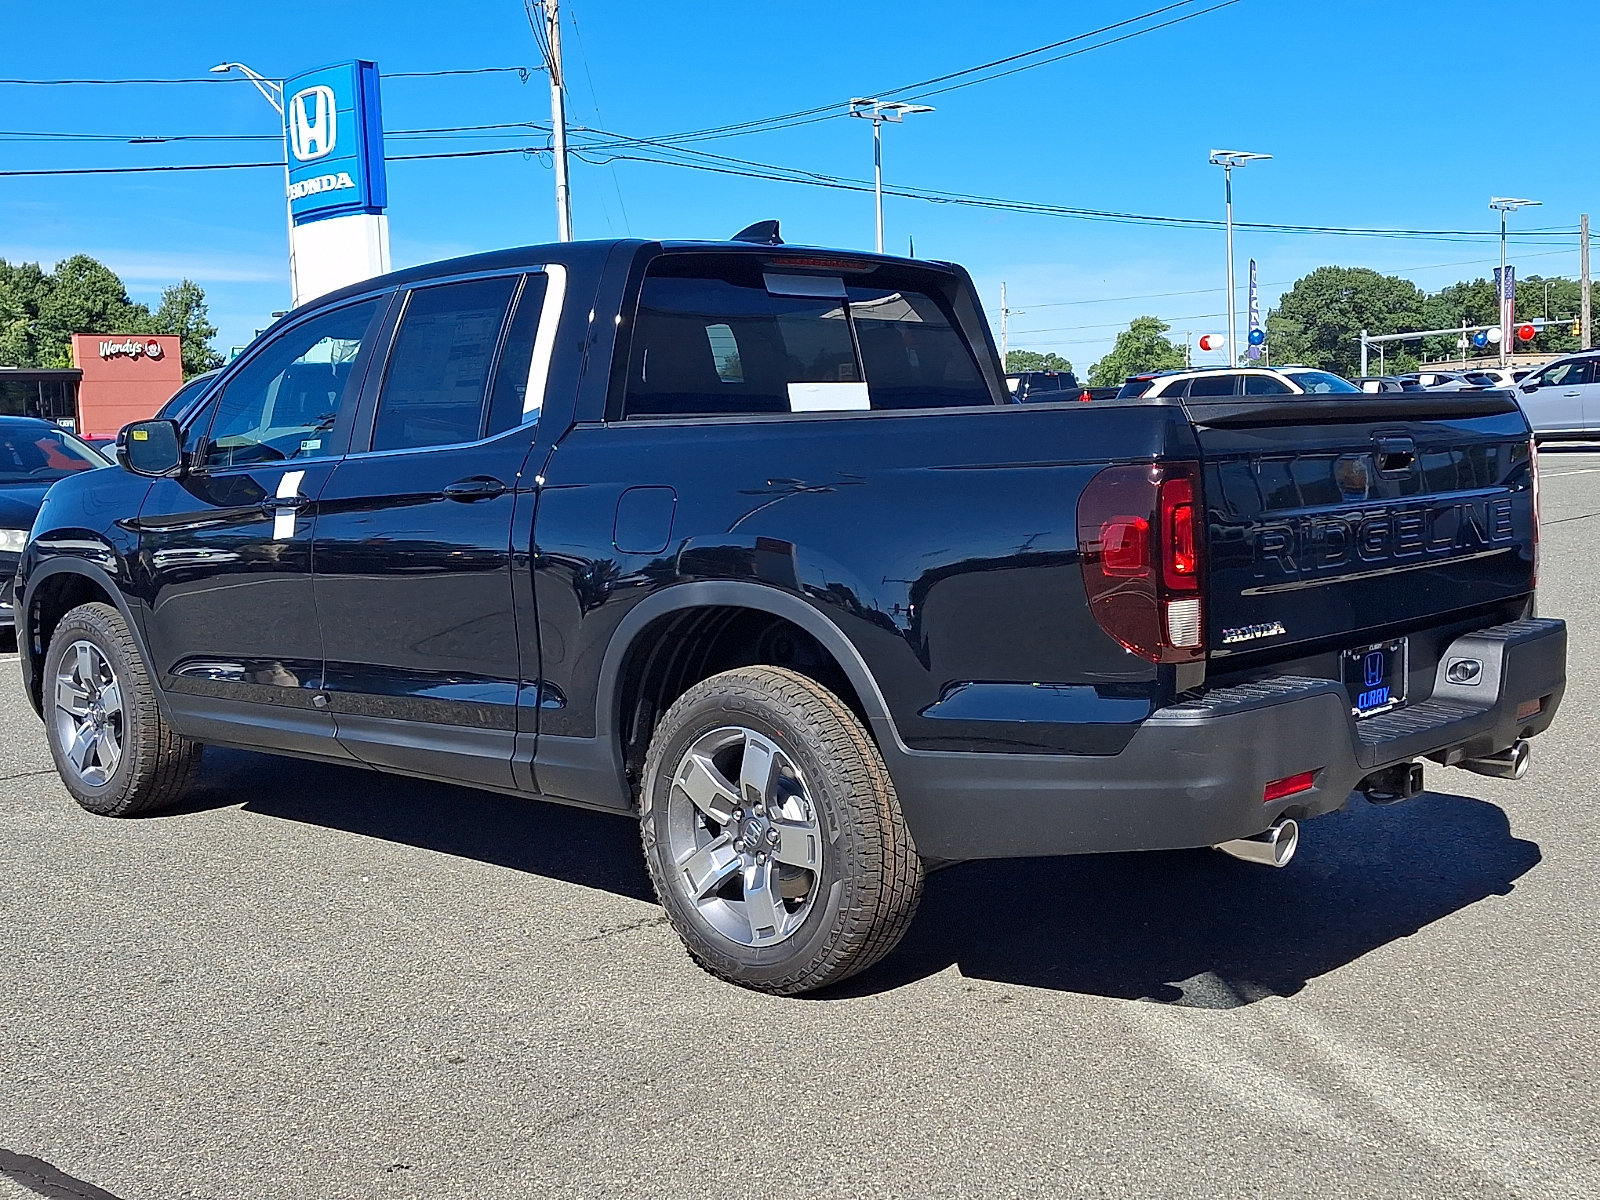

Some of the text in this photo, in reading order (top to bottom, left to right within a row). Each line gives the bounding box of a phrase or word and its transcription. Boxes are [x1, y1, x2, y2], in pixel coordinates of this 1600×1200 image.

[288, 172, 355, 201] HONDA
[99, 339, 142, 357] Wendy's
[1253, 498, 1513, 578] RIDGELINE
[1358, 686, 1390, 709] CURRY
